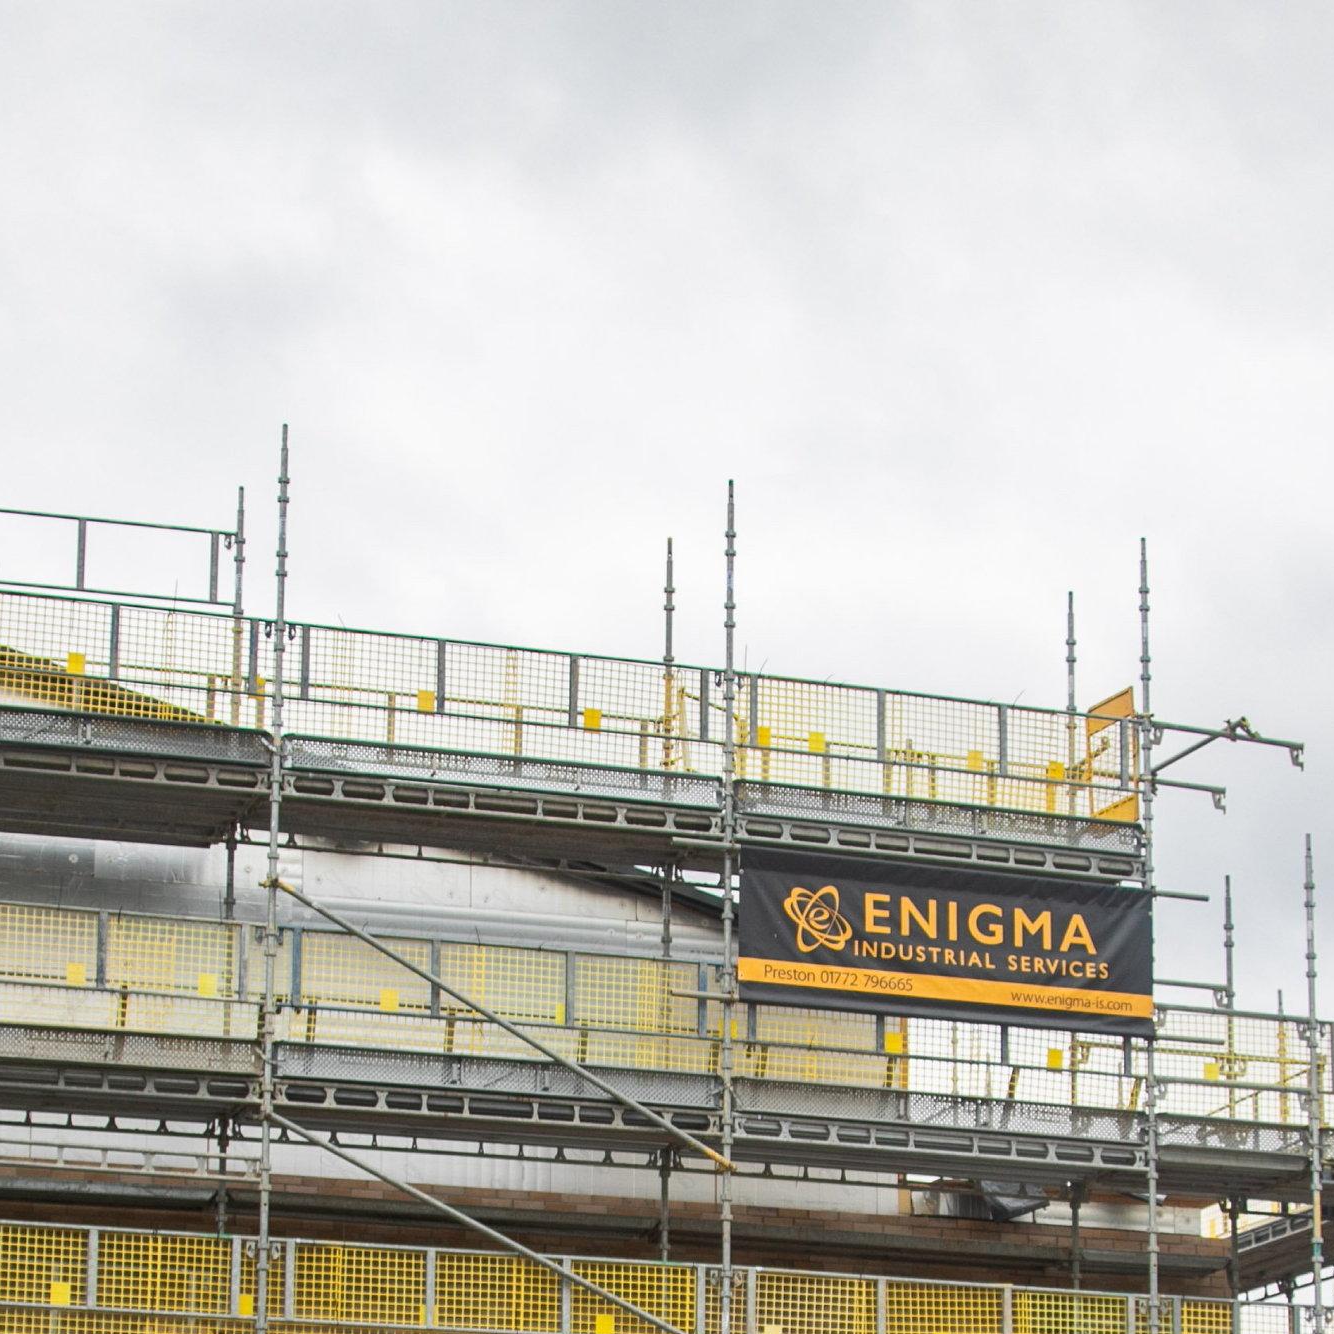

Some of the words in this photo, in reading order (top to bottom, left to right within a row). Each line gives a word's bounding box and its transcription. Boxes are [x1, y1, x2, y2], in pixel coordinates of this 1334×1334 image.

[864, 892, 1097, 955] ENIGMA
[853, 940, 996, 969] INDUSTRIAL
[1007, 954, 1109, 979] SERVICES
[764, 964, 816, 983] Preston
[820, 970, 858, 987] 01772
[864, 974, 913, 992] 796665
[1010, 991, 1133, 1012] www.enigma-is.com
